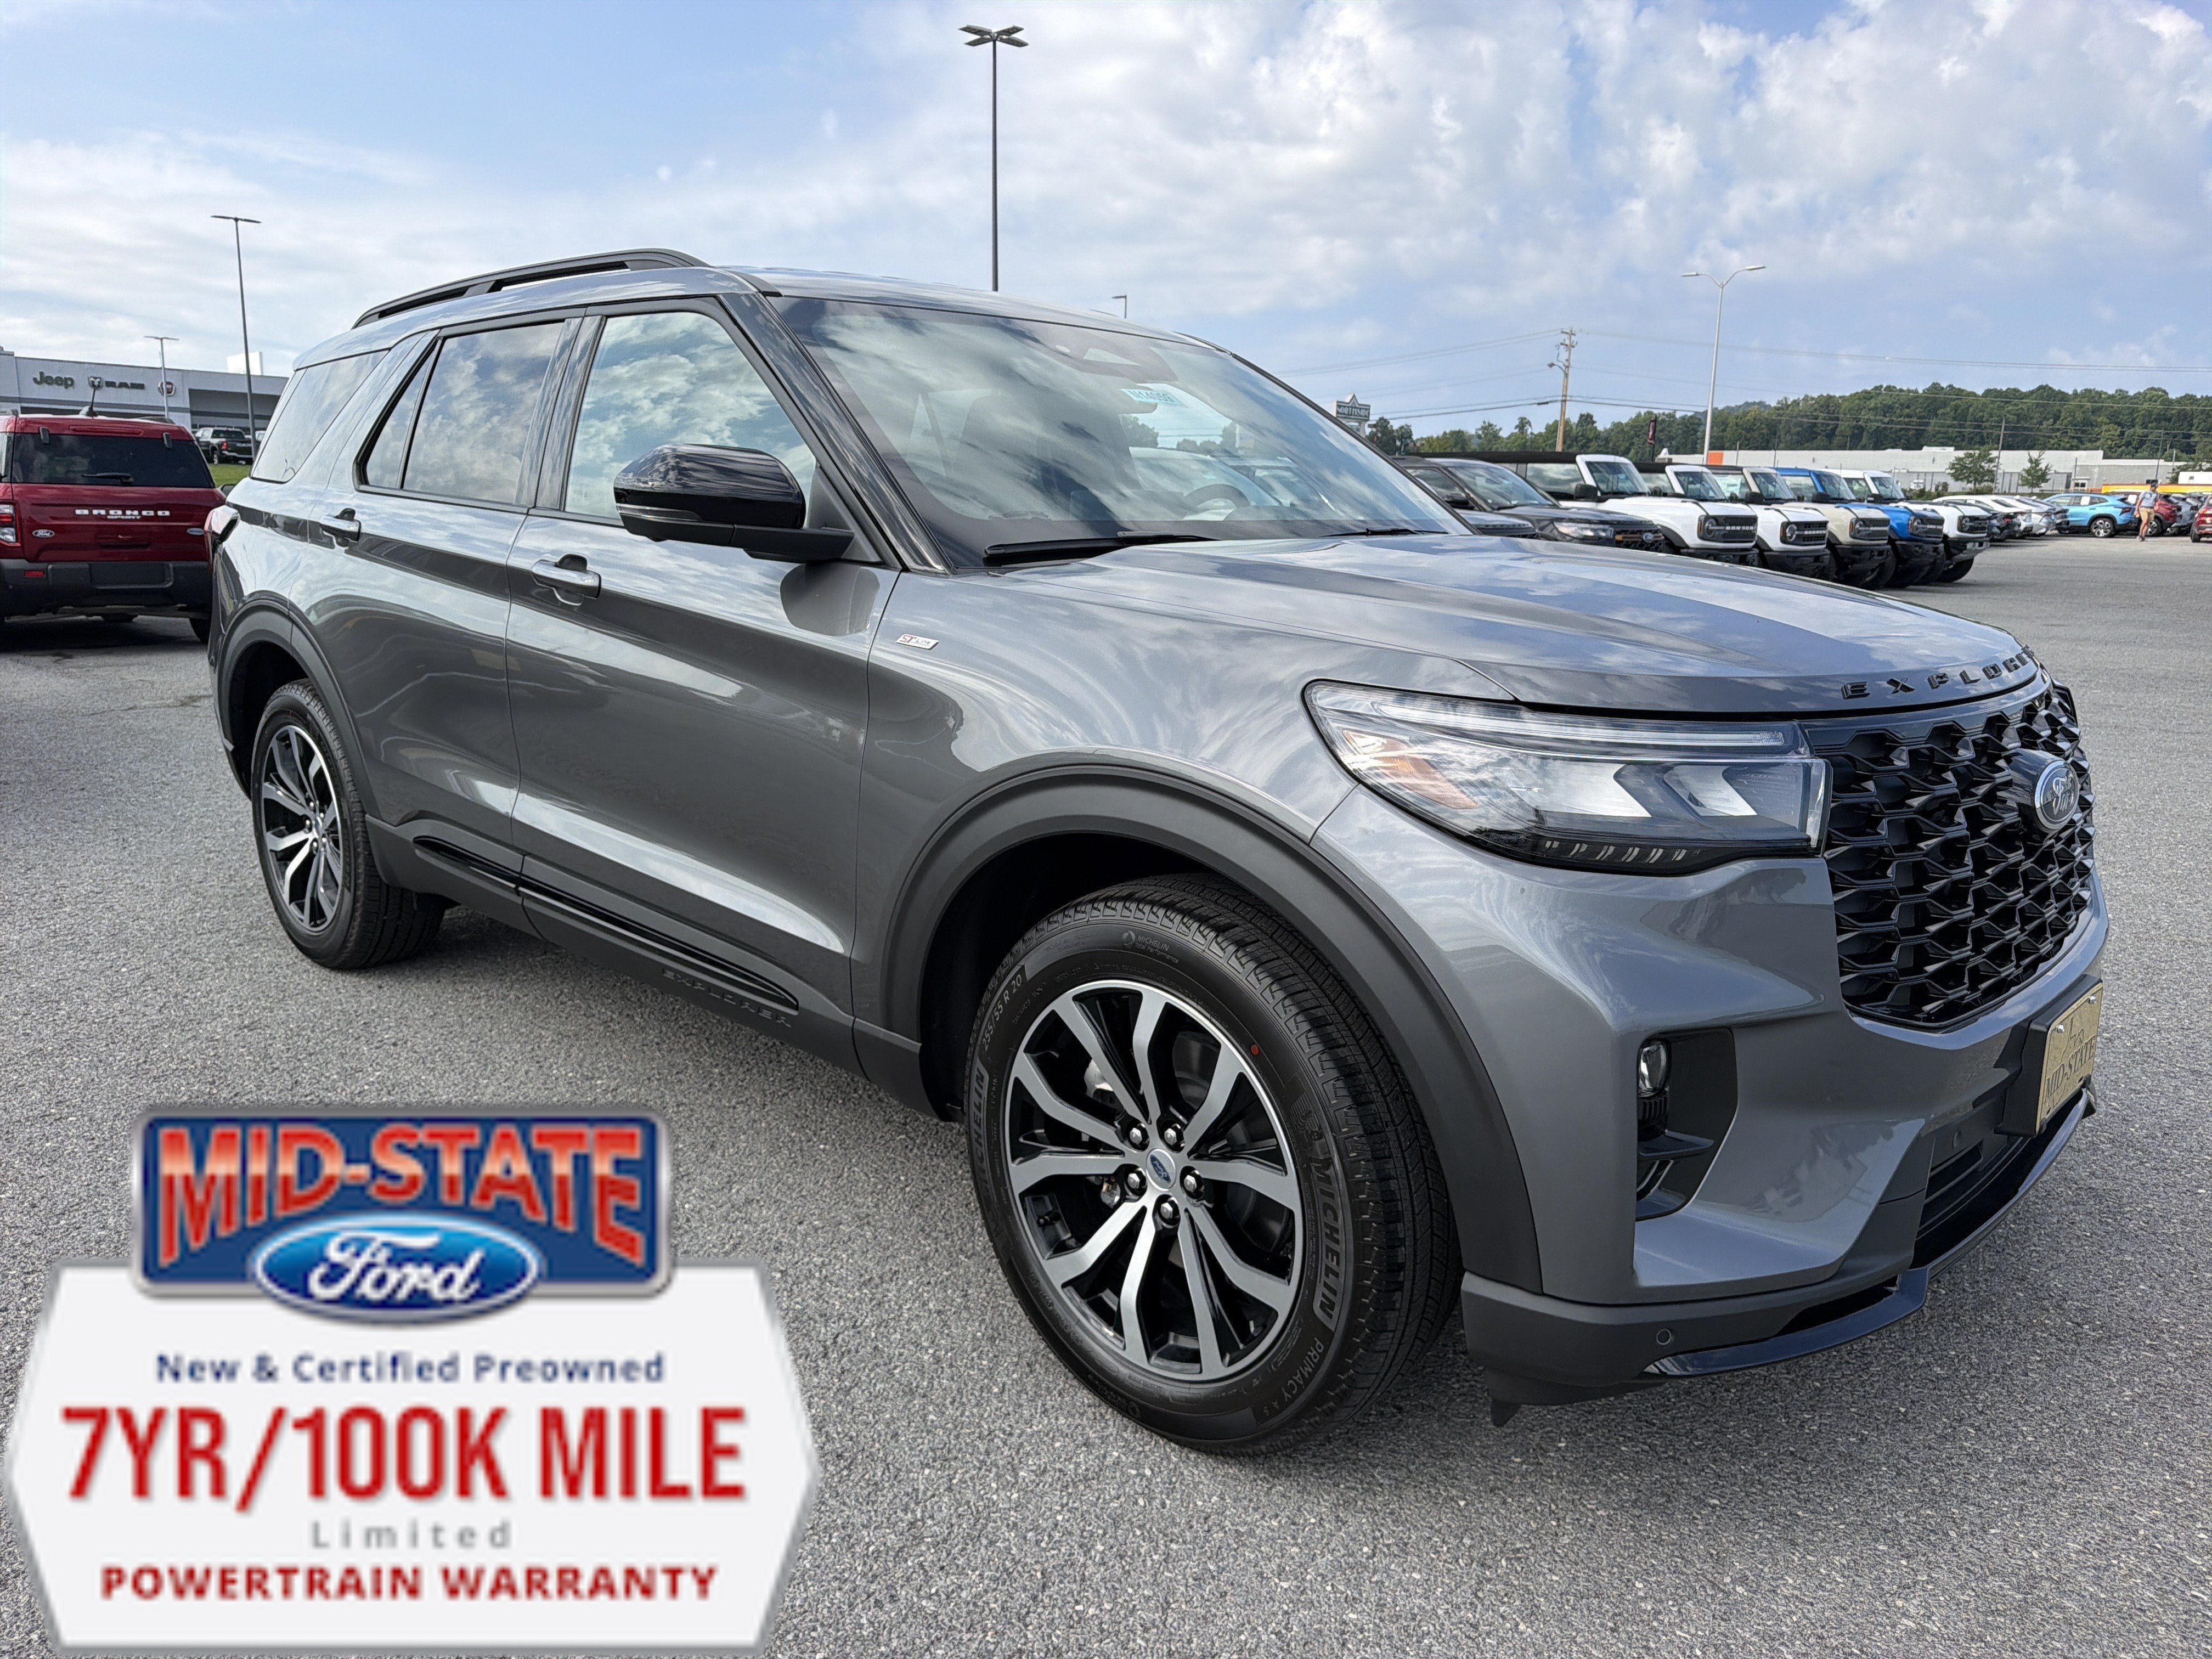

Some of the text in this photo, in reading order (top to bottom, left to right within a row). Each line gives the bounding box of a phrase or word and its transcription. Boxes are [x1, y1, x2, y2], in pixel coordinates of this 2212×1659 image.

[32, 371, 74, 389] Jeep
[1137, 935, 1170, 951] MICHELIN
[983, 1000, 1003, 1052] 255/55
[1003, 990, 1010, 1004] R
[1012, 974, 1023, 994] 20
[2046, 1035, 2097, 1099] MID-STATE
[1314, 1159, 1340, 1321] MICHELIN
[1282, 1336, 1324, 1402] PRIMACY
